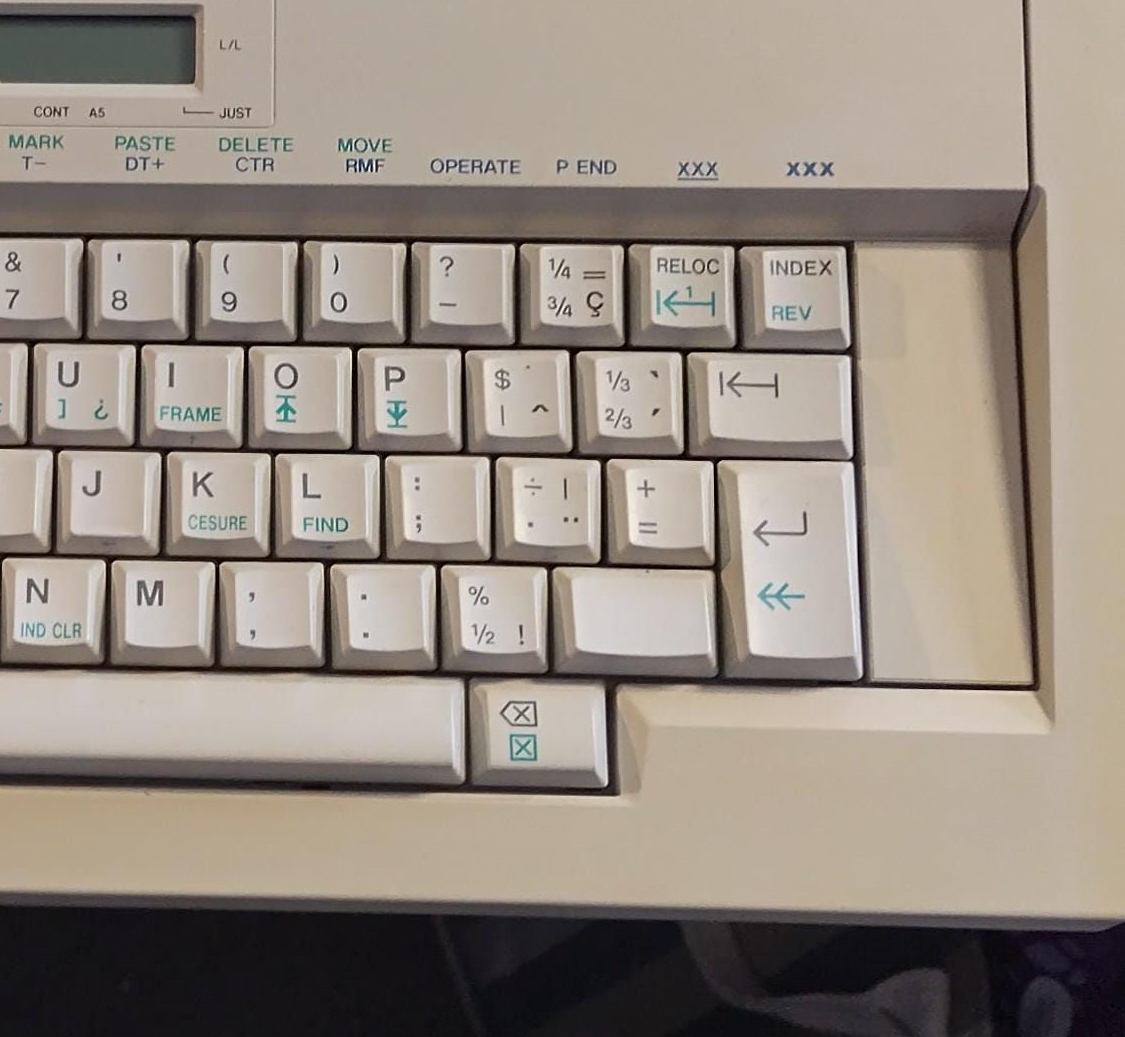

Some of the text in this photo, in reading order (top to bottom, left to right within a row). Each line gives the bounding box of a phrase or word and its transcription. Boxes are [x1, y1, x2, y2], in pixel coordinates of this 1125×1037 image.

[220, 40, 241, 50] L/L
[34, 106, 69, 117] CONT
[89, 108, 105, 118] A5
[219, 107, 251, 119] JUST
[9, 135, 63, 149] MARK
[115, 136, 174, 151] PASTE
[219, 138, 293, 152] DELETE
[338, 138, 391, 153] MOVE
[126, 157, 163, 171] DT+
[236, 157, 274, 172] CTR
[346, 159, 384, 173] RMF
[431, 159, 520, 174] OPERATE
[557, 160, 616, 174] P END
[679, 162, 719, 176] XXX
[5, 252, 21, 272] &
[440, 256, 454, 276] ?
[658, 258, 719, 275] RELOC
[771, 260, 832, 276] INDEX
[6, 289, 19, 309] 7
[112, 290, 127, 311] 8
[222, 292, 237, 312] 9
[331, 292, 347, 313] 0
[773, 305, 812, 321] REV
[58, 361, 79, 387] U
[385, 366, 405, 391] P
[495, 369, 511, 390] $
[161, 406, 222, 422] FRAME
[82, 471, 101, 496] J
[193, 472, 213, 497] K
[303, 473, 321, 499] L
[189, 515, 247, 531] CESURE
[304, 518, 348, 532] FIND
[27, 578, 49, 604] N
[137, 580, 163, 606] M
[469, 586, 489, 605] %
[21, 622, 82, 639] IND CLR
